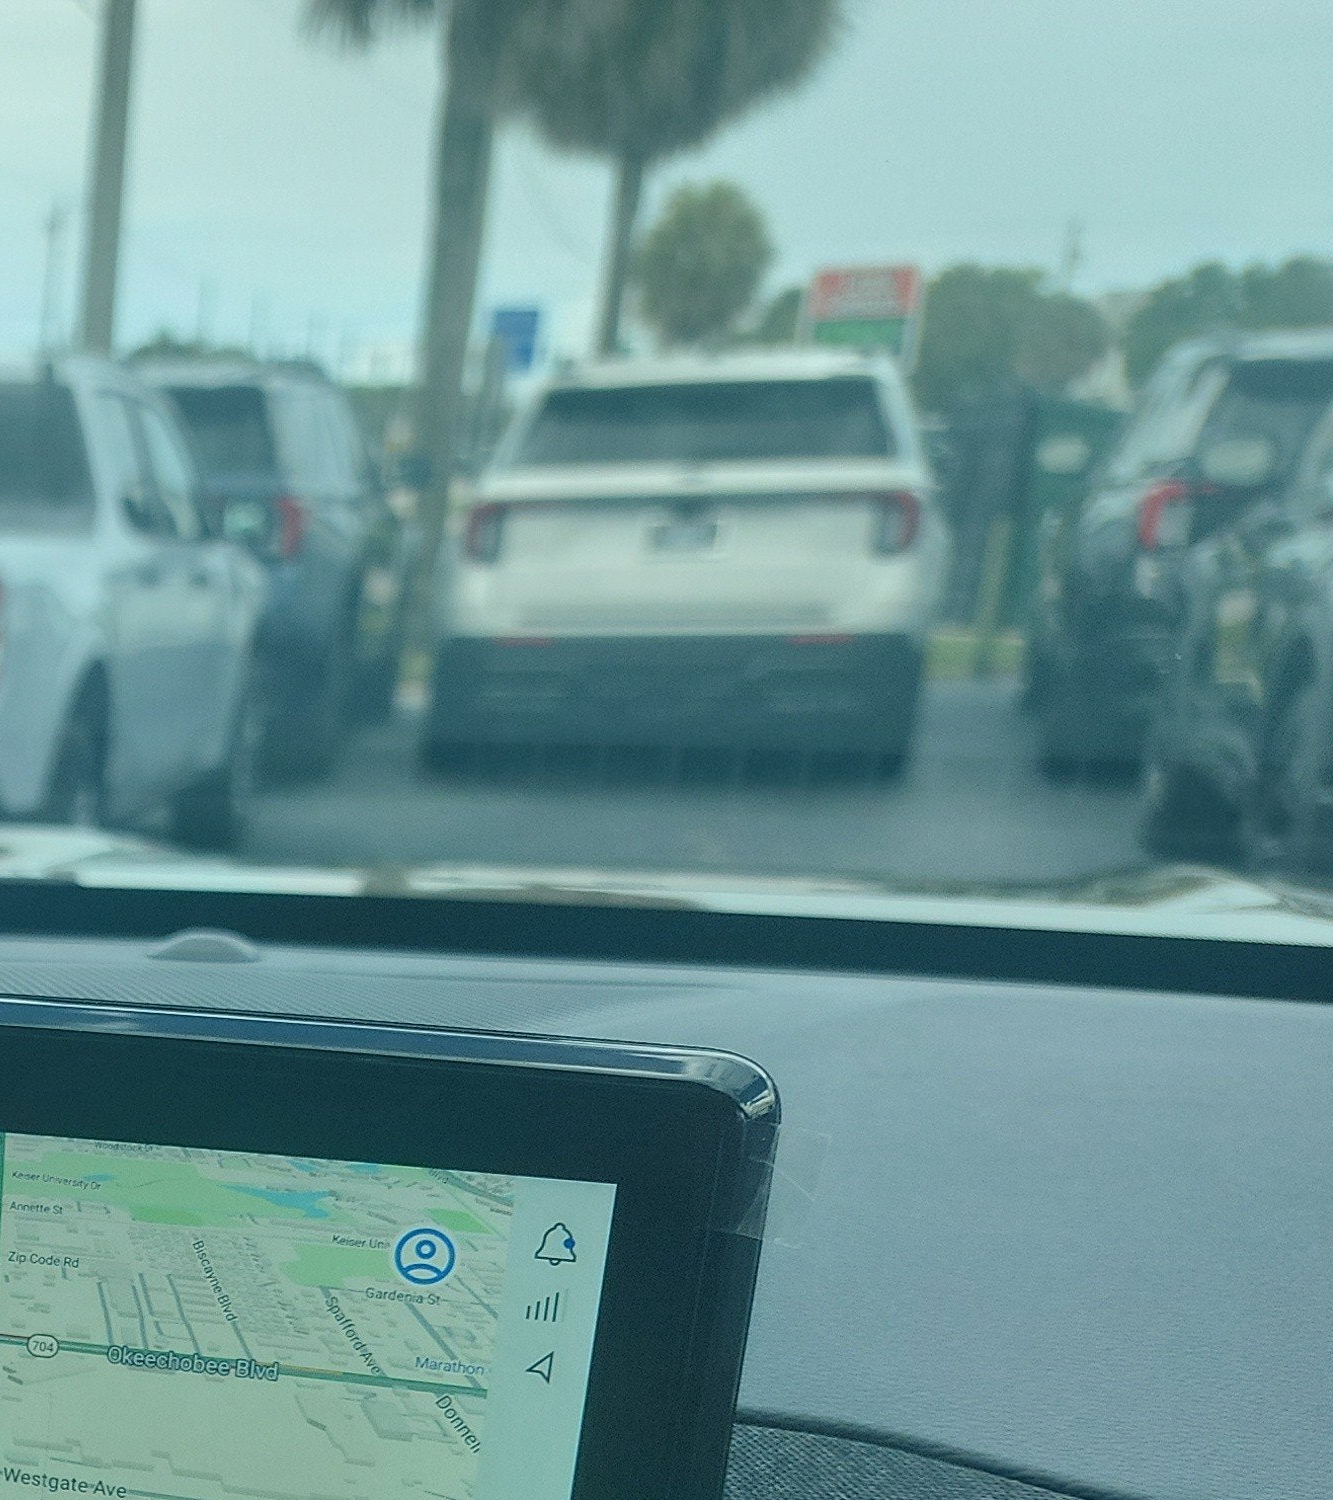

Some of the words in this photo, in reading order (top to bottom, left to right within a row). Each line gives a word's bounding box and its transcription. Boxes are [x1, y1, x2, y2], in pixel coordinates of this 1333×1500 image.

[12, 1170, 40, 1182] Keiser
[42, 1174, 89, 1191] University
[91, 1181, 102, 1191] Dr
[9, 1200, 50, 1213] Annette
[52, 1205, 63, 1215] St
[332, 1234, 365, 1248] Keiser
[8, 1251, 27, 1265] Zip
[29, 1253, 60, 1267] Code
[63, 1257, 80, 1268] Rd
[193, 1239, 225, 1299] Biscayne
[217, 1293, 238, 1323] Blvd
[365, 1286, 424, 1304] Gardenia
[427, 1292, 442, 1305] St
[324, 1296, 369, 1352] Spafford
[356, 1348, 380, 1375] Ave
[32, 1339, 55, 1354] 704
[106, 1344, 231, 1377] Okeechobee
[235, 1357, 280, 1382] Blvd
[415, 1356, 485, 1375] Marathon
[2, 1466, 88, 1496] Westgate
[92, 1478, 129, 1499] Ave
